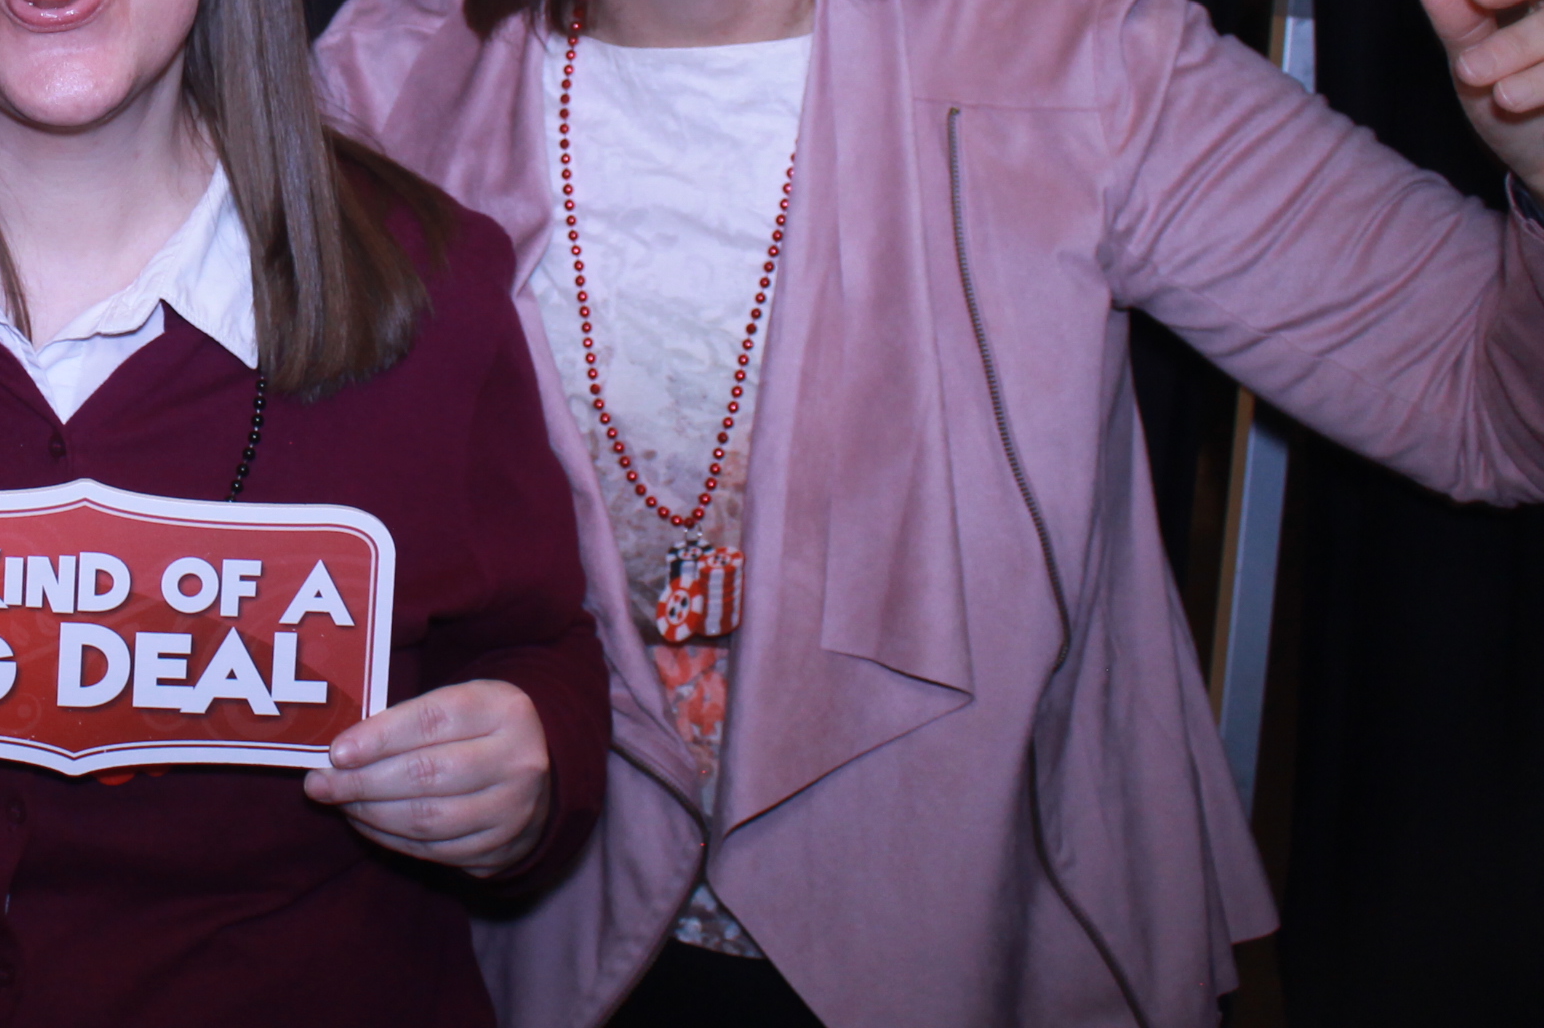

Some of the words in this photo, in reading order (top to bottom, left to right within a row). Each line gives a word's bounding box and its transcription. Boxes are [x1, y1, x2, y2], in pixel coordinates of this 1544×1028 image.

[161, 557, 262, 617] OF
[279, 559, 355, 626] A
[57, 622, 328, 716] DEAL
